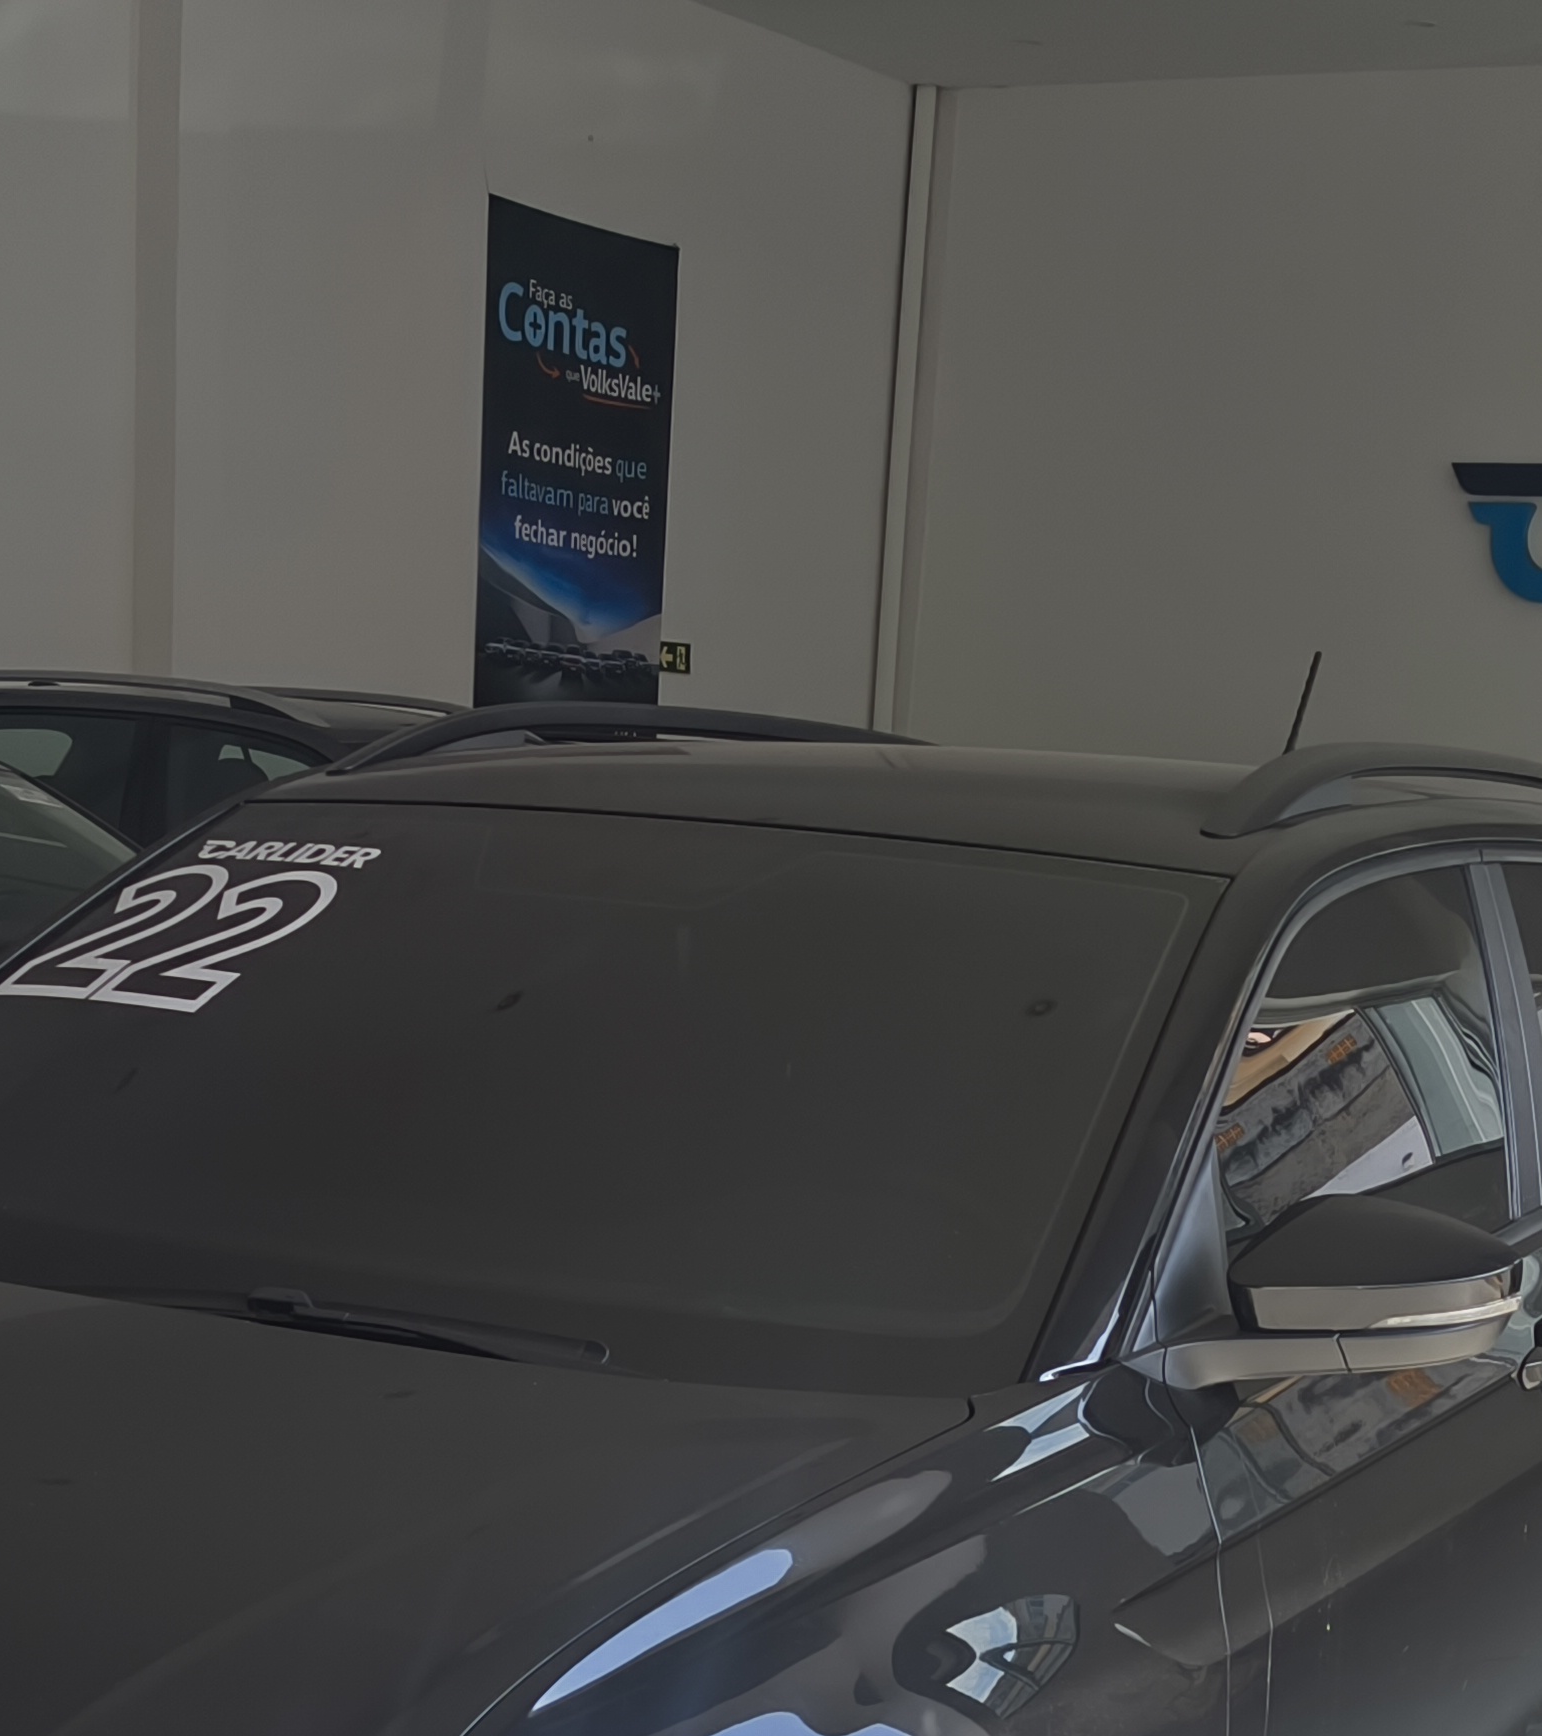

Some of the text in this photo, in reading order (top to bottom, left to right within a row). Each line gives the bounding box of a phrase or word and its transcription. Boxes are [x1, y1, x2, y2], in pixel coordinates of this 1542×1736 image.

[528, 278, 573, 310] Faça as
[498, 281, 628, 368] Contas
[565, 368, 581, 382] que
[508, 431, 648, 483] As condições que
[500, 470, 651, 520] faltavam para você
[514, 514, 638, 559] fechar negócio!
[198, 839, 382, 869] CARLIDER
